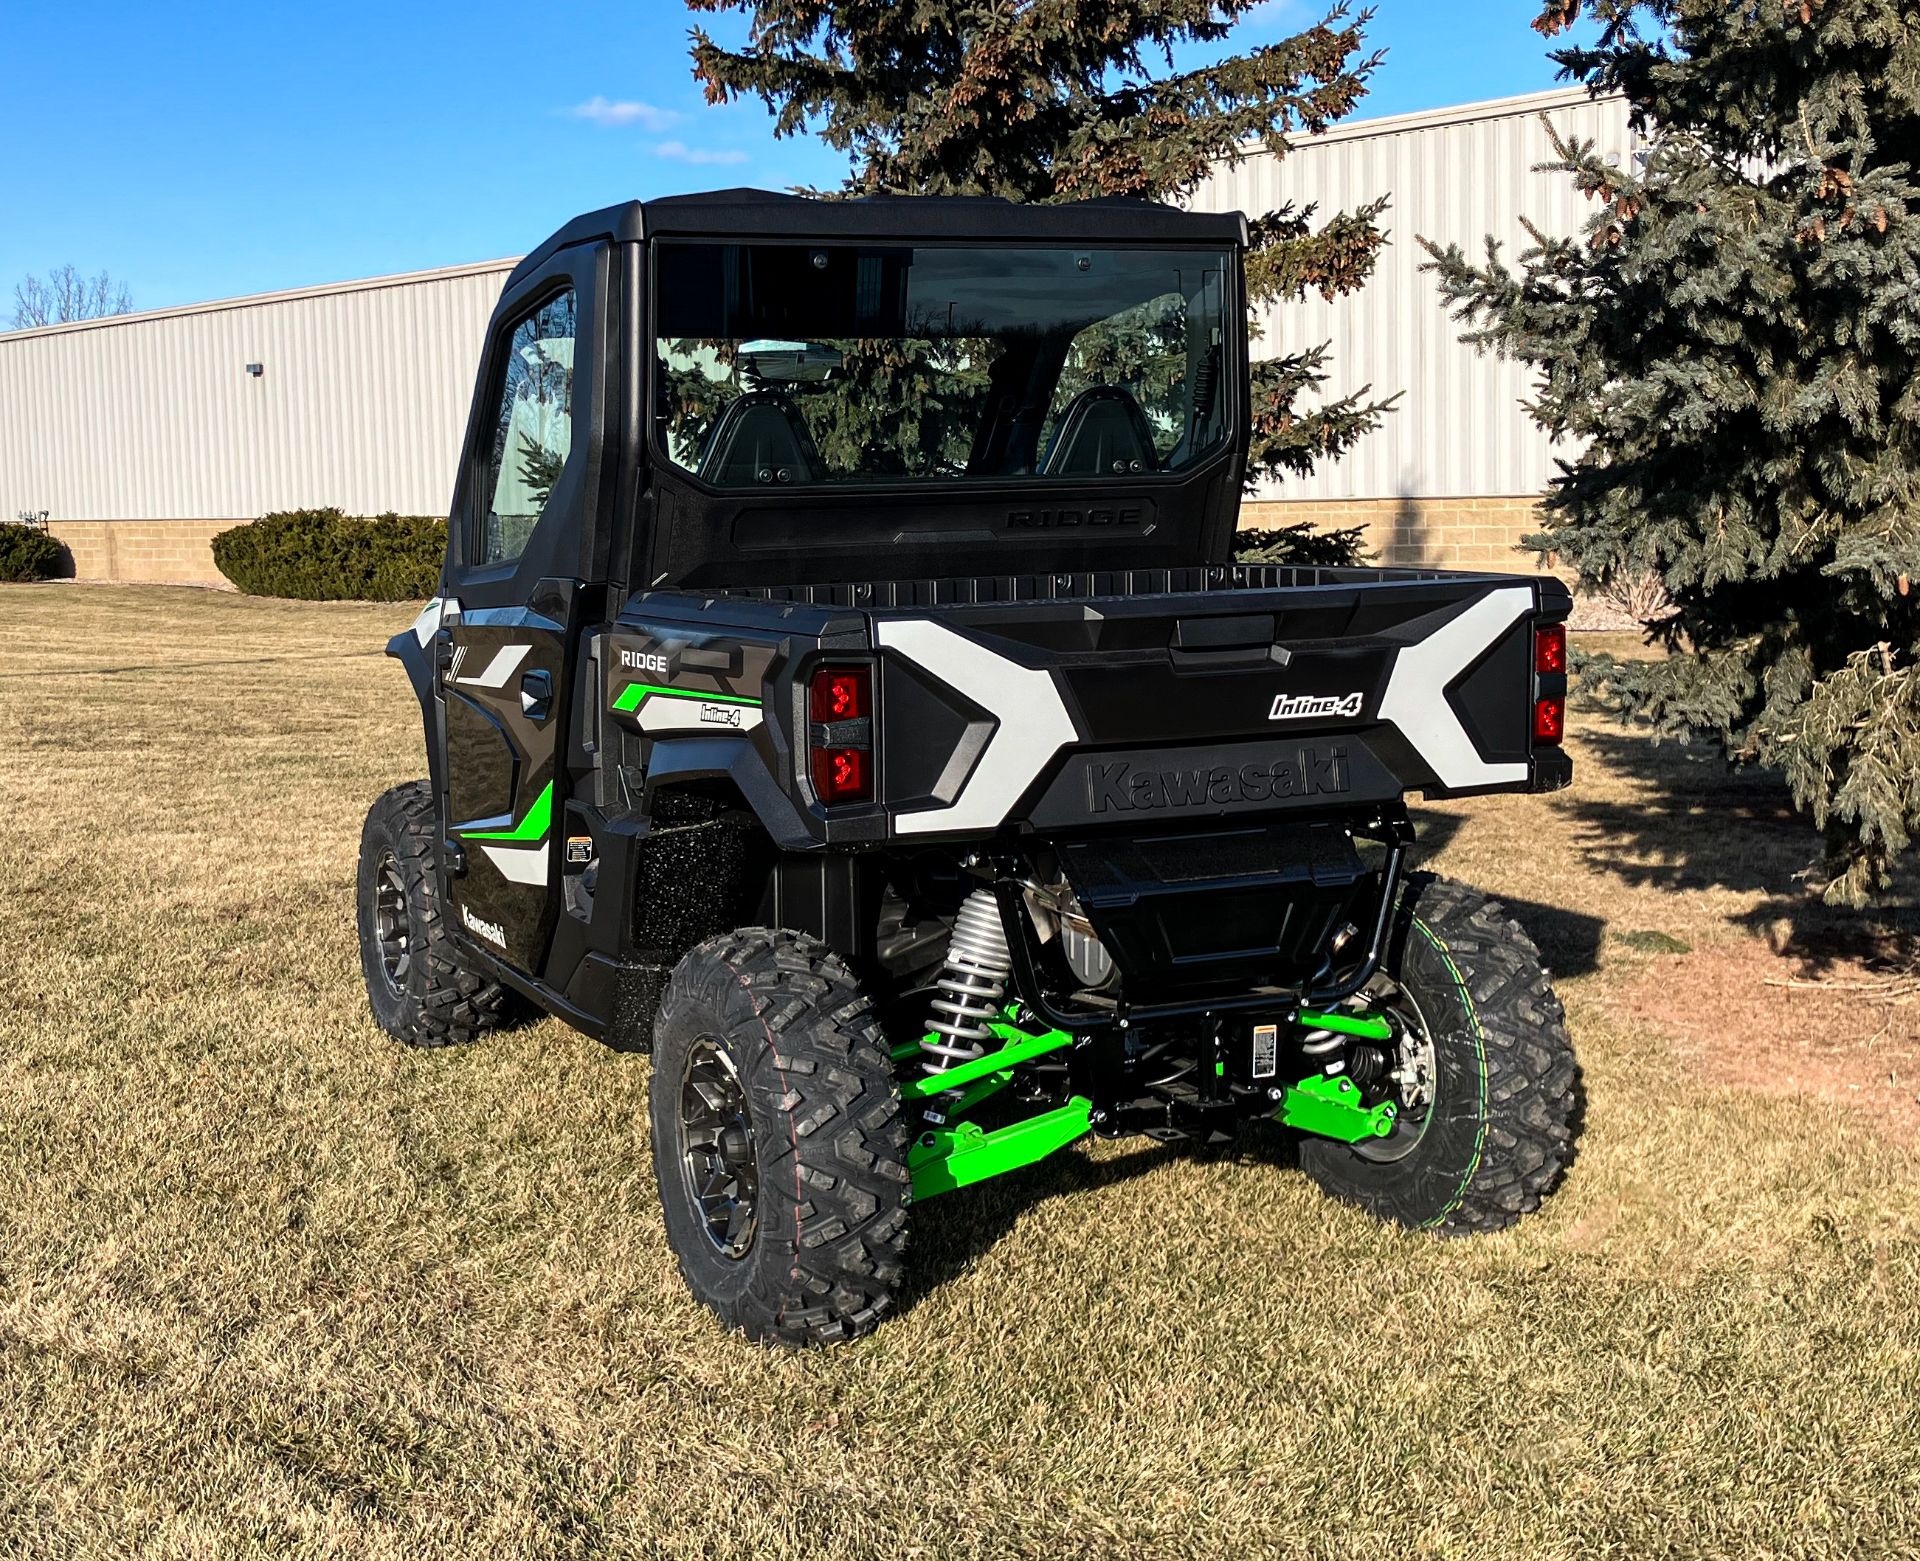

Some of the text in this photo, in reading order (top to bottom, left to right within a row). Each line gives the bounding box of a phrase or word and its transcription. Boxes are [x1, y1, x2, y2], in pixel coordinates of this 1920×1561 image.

[1007, 508, 1141, 529] RIDGE
[621, 650, 667, 673] RIDGE
[701, 703, 741, 727] Inline-4
[1269, 692, 1364, 720] Inline-4
[1086, 746, 1350, 814] Kawasaki
[461, 903, 507, 949] Kawasaki
